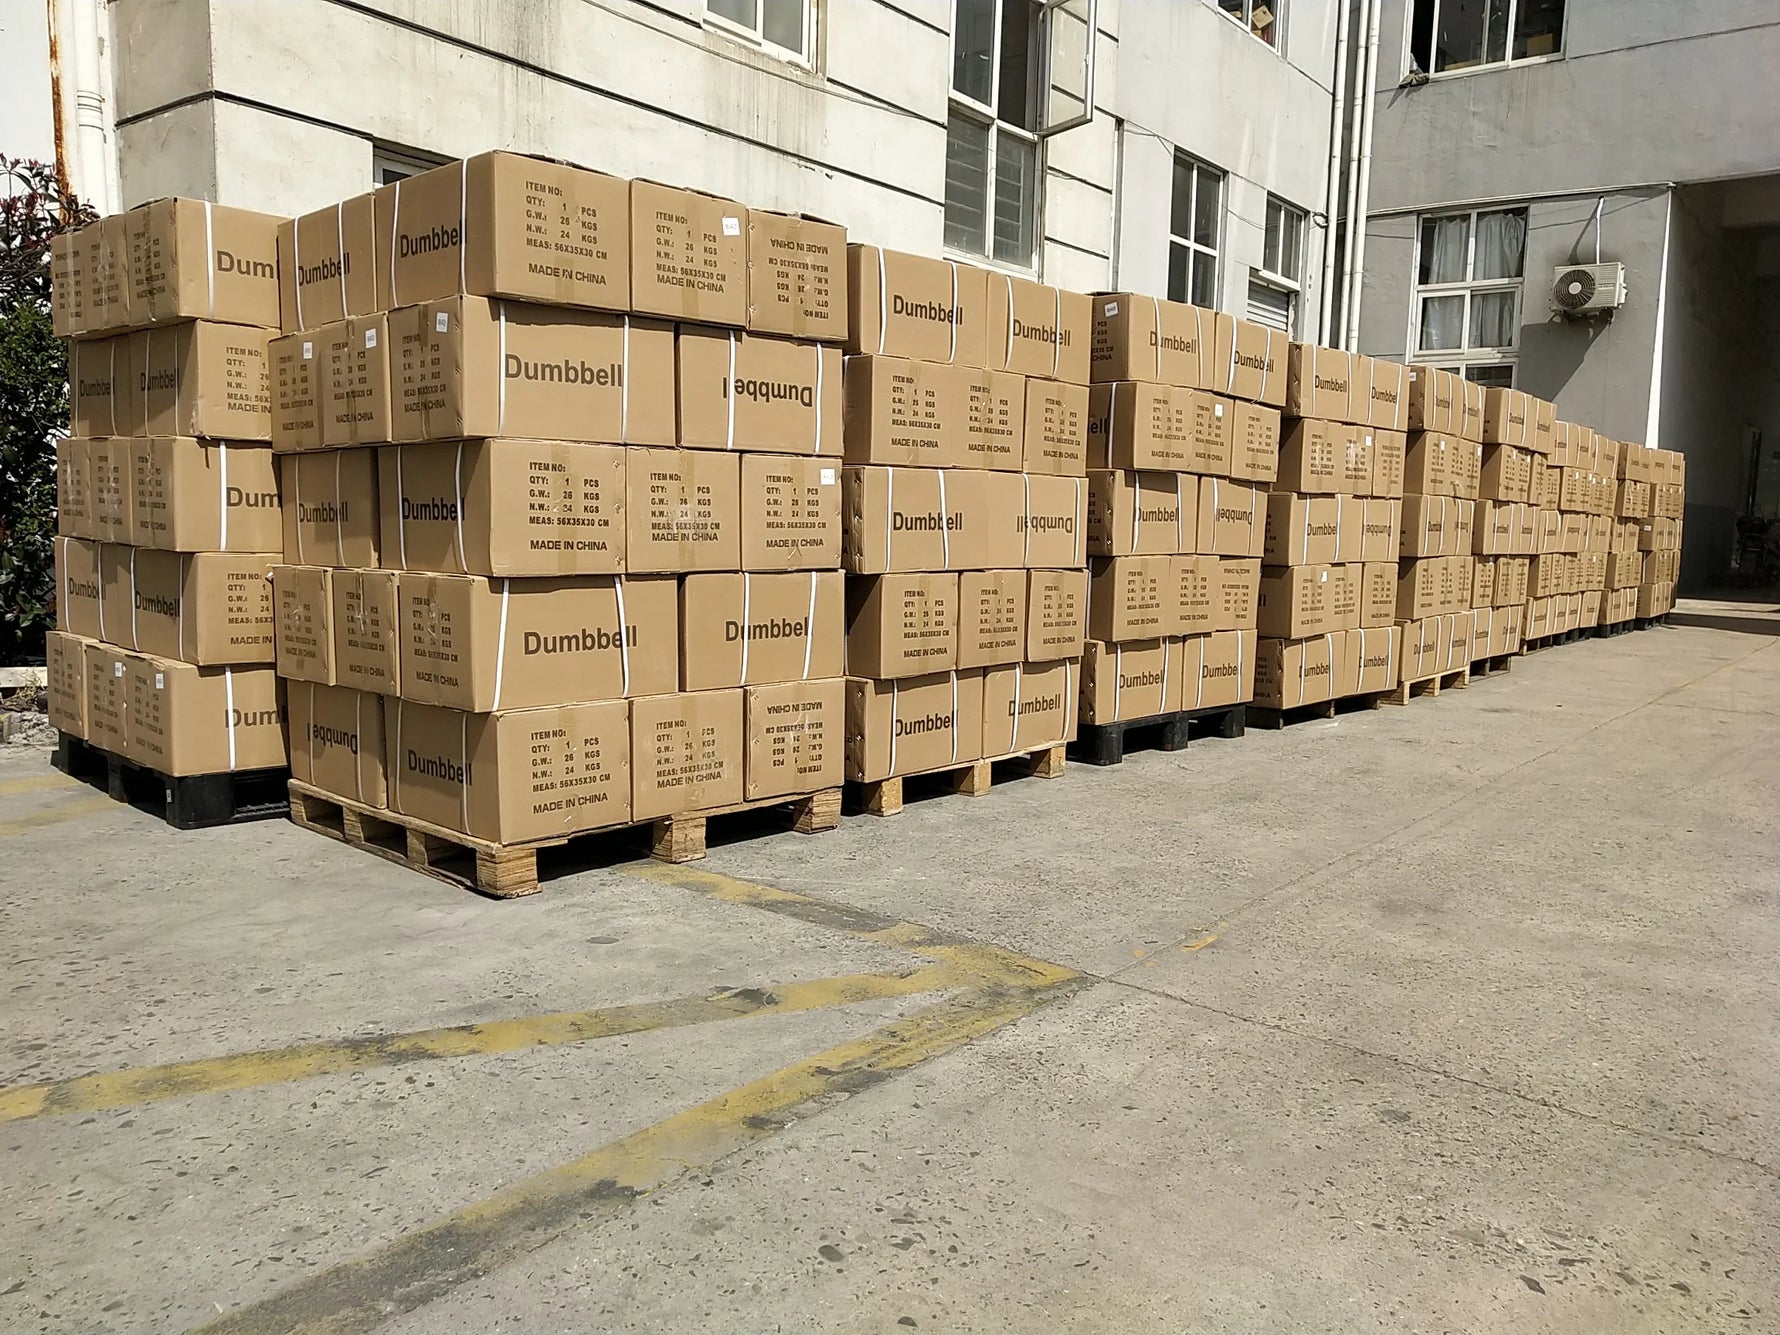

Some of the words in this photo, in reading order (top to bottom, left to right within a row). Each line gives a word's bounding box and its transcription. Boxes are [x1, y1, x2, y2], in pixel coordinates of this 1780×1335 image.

[526, 181, 546, 192] ITEM
[548, 186, 562, 196] NO:
[526, 196, 545, 206] QTY:
[562, 203, 566, 211] 1
[582, 207, 596, 217] PCS
[526, 210, 547, 221] G.W.:
[560, 216, 570, 225] 26
[582, 221, 597, 231] KGS
[656, 212, 674, 223] ITEM
[675, 216, 687, 224] NO:
[526, 224, 547, 234] N.W.:
[561, 230, 570, 239] 24
[582, 235, 597, 244] KGS
[656, 225, 672, 234] QTY:
[704, 234, 716, 243] PCS
[526, 238, 552, 249] MEAS:
[555, 243, 593, 258] 56X35X30
[596, 251, 607, 260] CM
[656, 238, 674, 248] G.W.:
[704, 246, 717, 255] KGS
[770, 238, 794, 250] CHINA
[795, 243, 804, 251] IN
[807, 243, 828, 255] MADE
[217, 250, 276, 279] Dum
[656, 251, 674, 260] N.W.:
[704, 259, 717, 268] KGS
[528, 263, 560, 277] MADE
[563, 269, 572, 279] IN
[576, 272, 606, 285] CHINA
[656, 263, 678, 275] MEAS:
[680, 267, 714, 281] 56X35X30
[716, 273, 726, 281] CM
[657, 274, 684, 287] MADE
[686, 279, 695, 288] IN
[697, 281, 724, 294] CHINA
[226, 347, 246, 355] ITEM
[226, 358, 245, 366] QTY:
[226, 370, 247, 378] G.W.:
[505, 353, 623, 387] Dumbbell
[80, 376, 115, 397] Dumbbel
[226, 381, 247, 390] N.W.:
[722, 377, 813, 407] Dumbbel
[227, 392, 252, 402] MEAS:
[228, 402, 259, 412] MADE
[261, 405, 271, 413] IN
[530, 462, 549, 471] ITEM
[552, 464, 566, 472] NO:
[530, 476, 548, 484] QTY:
[584, 479, 599, 487] PCS
[530, 490, 550, 498] G.W.:
[563, 491, 572, 499] 26
[401, 497, 465, 521] Dumbbel
[530, 503, 549, 511] N.W.:
[557, 518, 594, 526] 56X35X30
[530, 540, 561, 550] MADE
[564, 541, 573, 550] IN
[577, 541, 607, 550] CHINA
[725, 617, 813, 642] Dumbbel
[230, 636, 260, 644] MADE
[262, 636, 272, 644] IN
[1202, 663, 1242, 680] Dumbbel
[1119, 672, 1163, 690] Dumbbel
[767, 704, 790, 714] CHINA
[792, 704, 799, 712] IN
[802, 702, 822, 711] MADE
[307, 723, 357, 755] Dumbbel
[531, 731, 550, 740] ITEM
[552, 729, 566, 738] NO:
[532, 745, 550, 753] QTY:
[584, 738, 599, 746] PCS
[532, 758, 552, 766] G.W.:
[564, 754, 573, 762] 26
[585, 750, 600, 759] KGS
[533, 771, 552, 779] N.W.:
[585, 763, 600, 771] KGS
[533, 782, 557, 792] MEAS:
[560, 776, 596, 788] 56X35X30
[600, 774, 610, 782] CM
[534, 801, 563, 814] MADE
[566, 799, 575, 808] IN
[578, 793, 608, 806] CHINA
